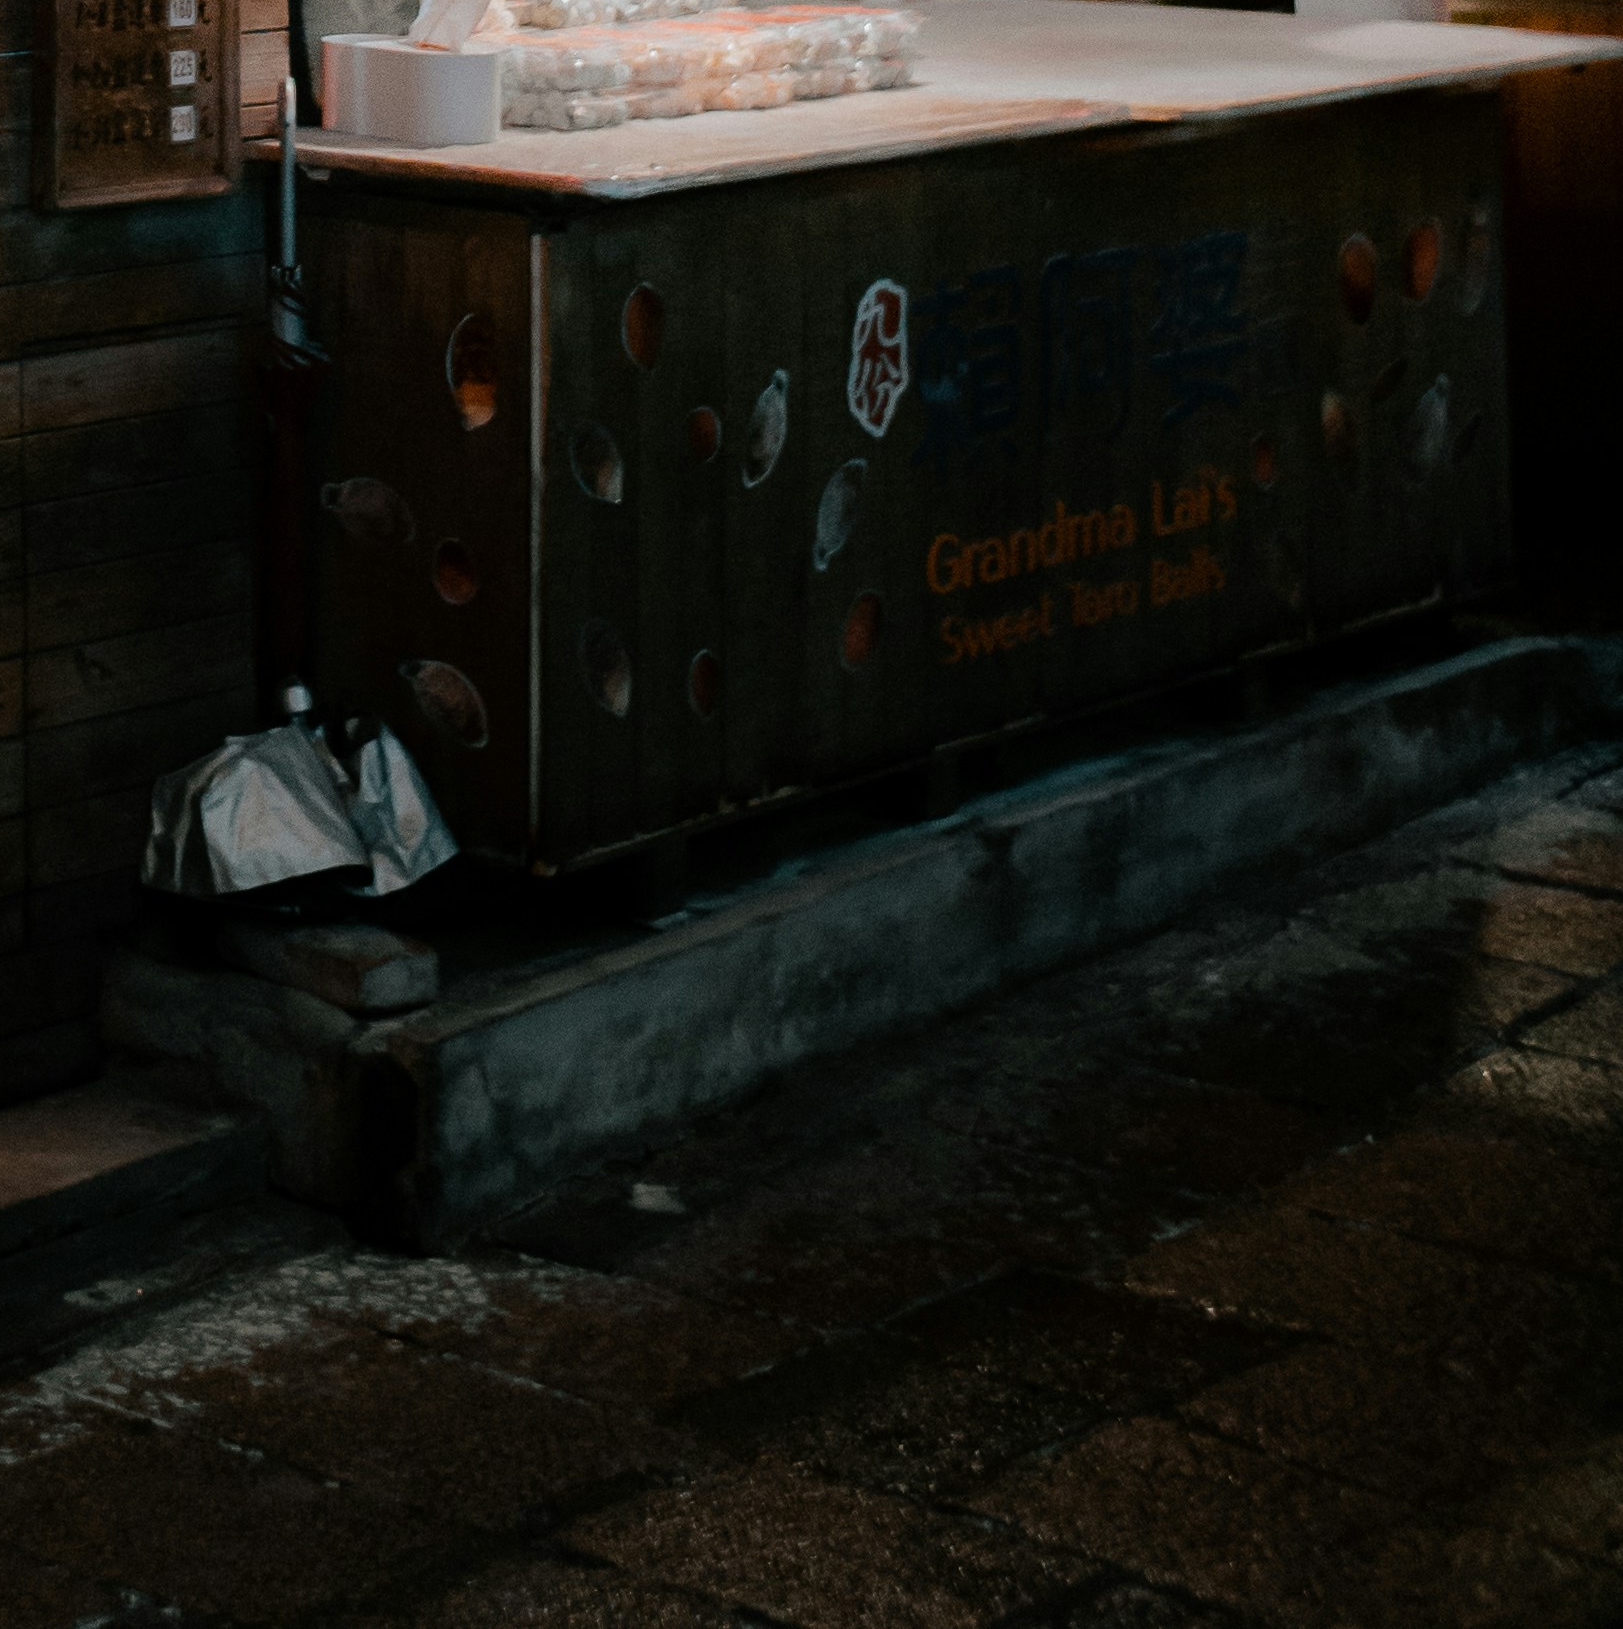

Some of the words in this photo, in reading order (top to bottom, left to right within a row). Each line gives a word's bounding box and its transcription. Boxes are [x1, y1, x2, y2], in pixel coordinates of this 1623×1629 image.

[850, 284, 908, 435] 九份
[911, 230, 1248, 484] 賴阿婆
[925, 499, 1138, 595] Grandma
[1149, 463, 1238, 537] Lai's
[939, 592, 1055, 665] Sweet
[1069, 579, 1139, 627] Taro
